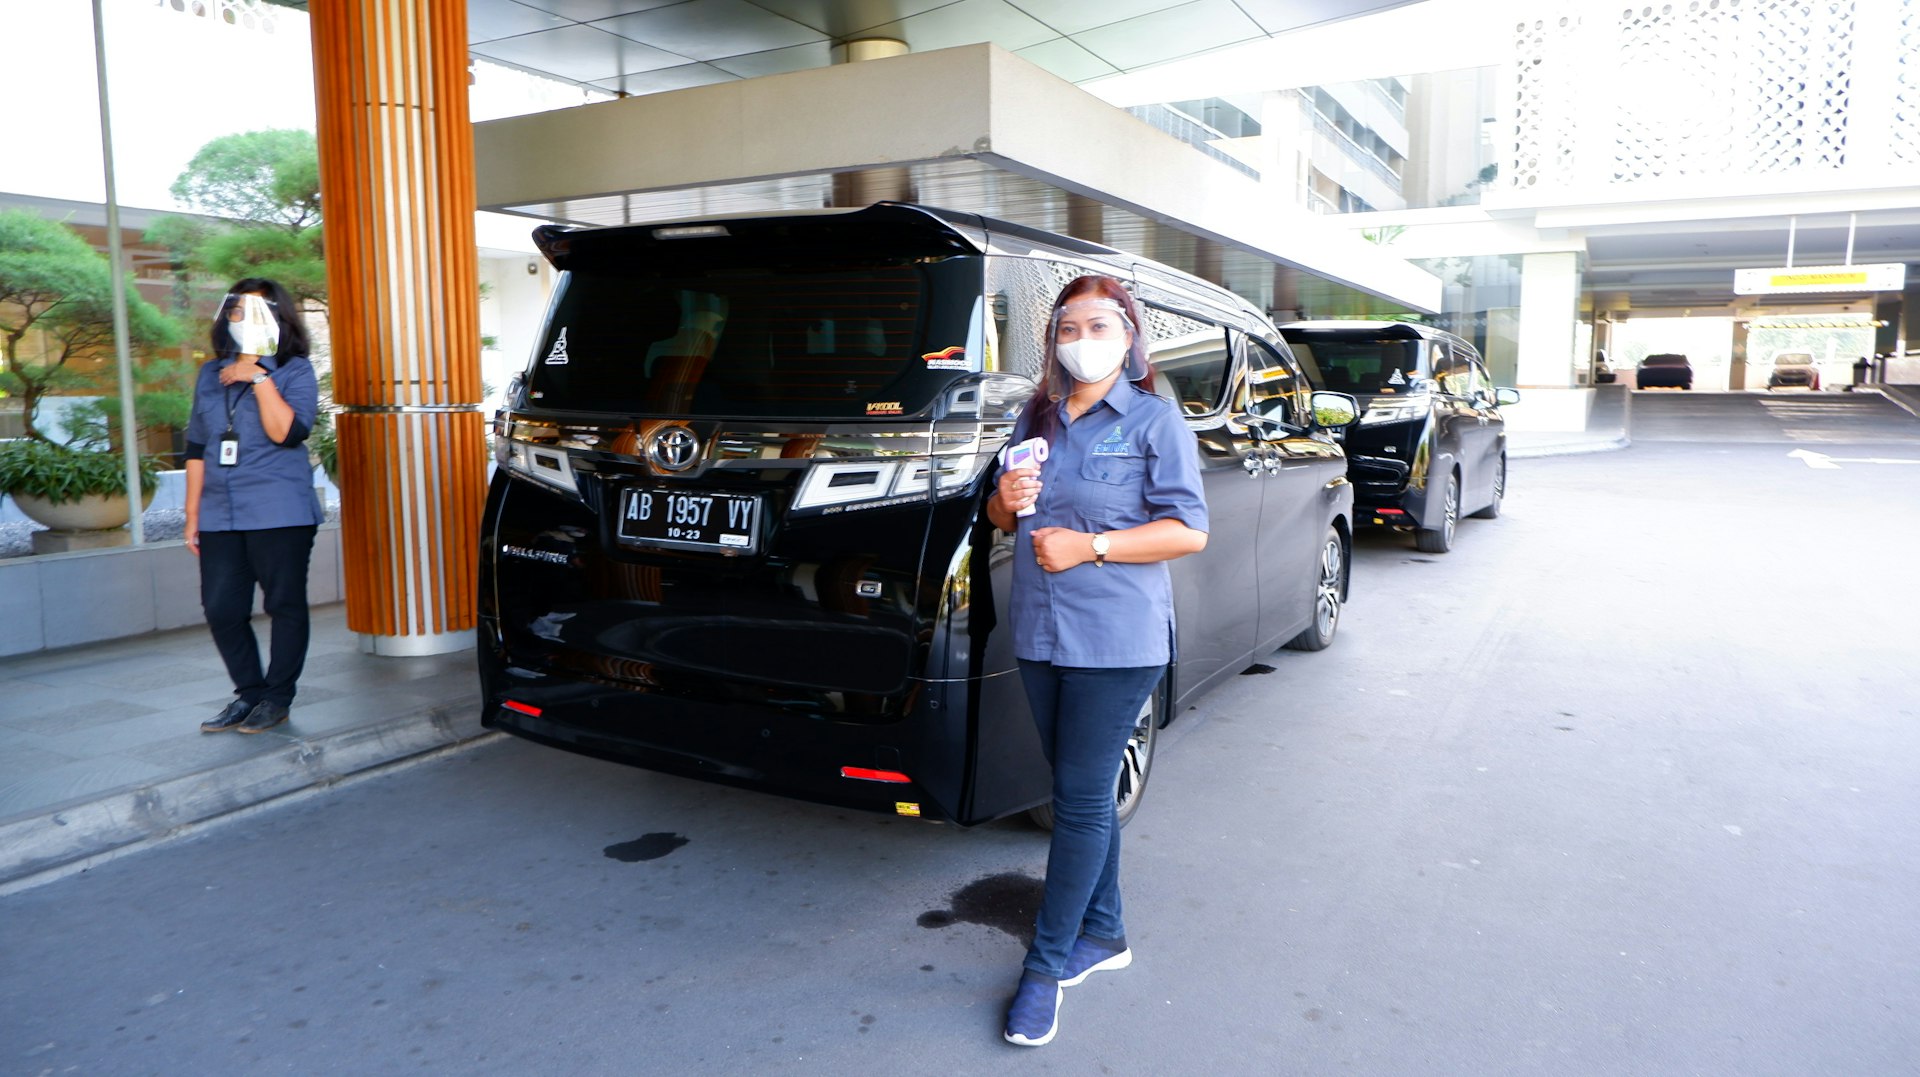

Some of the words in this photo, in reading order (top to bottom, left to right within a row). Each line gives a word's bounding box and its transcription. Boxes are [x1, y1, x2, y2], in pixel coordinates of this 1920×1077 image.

[626, 492, 653, 521] AB
[666, 494, 714, 527] 1957
[727, 499, 753, 530] VY
